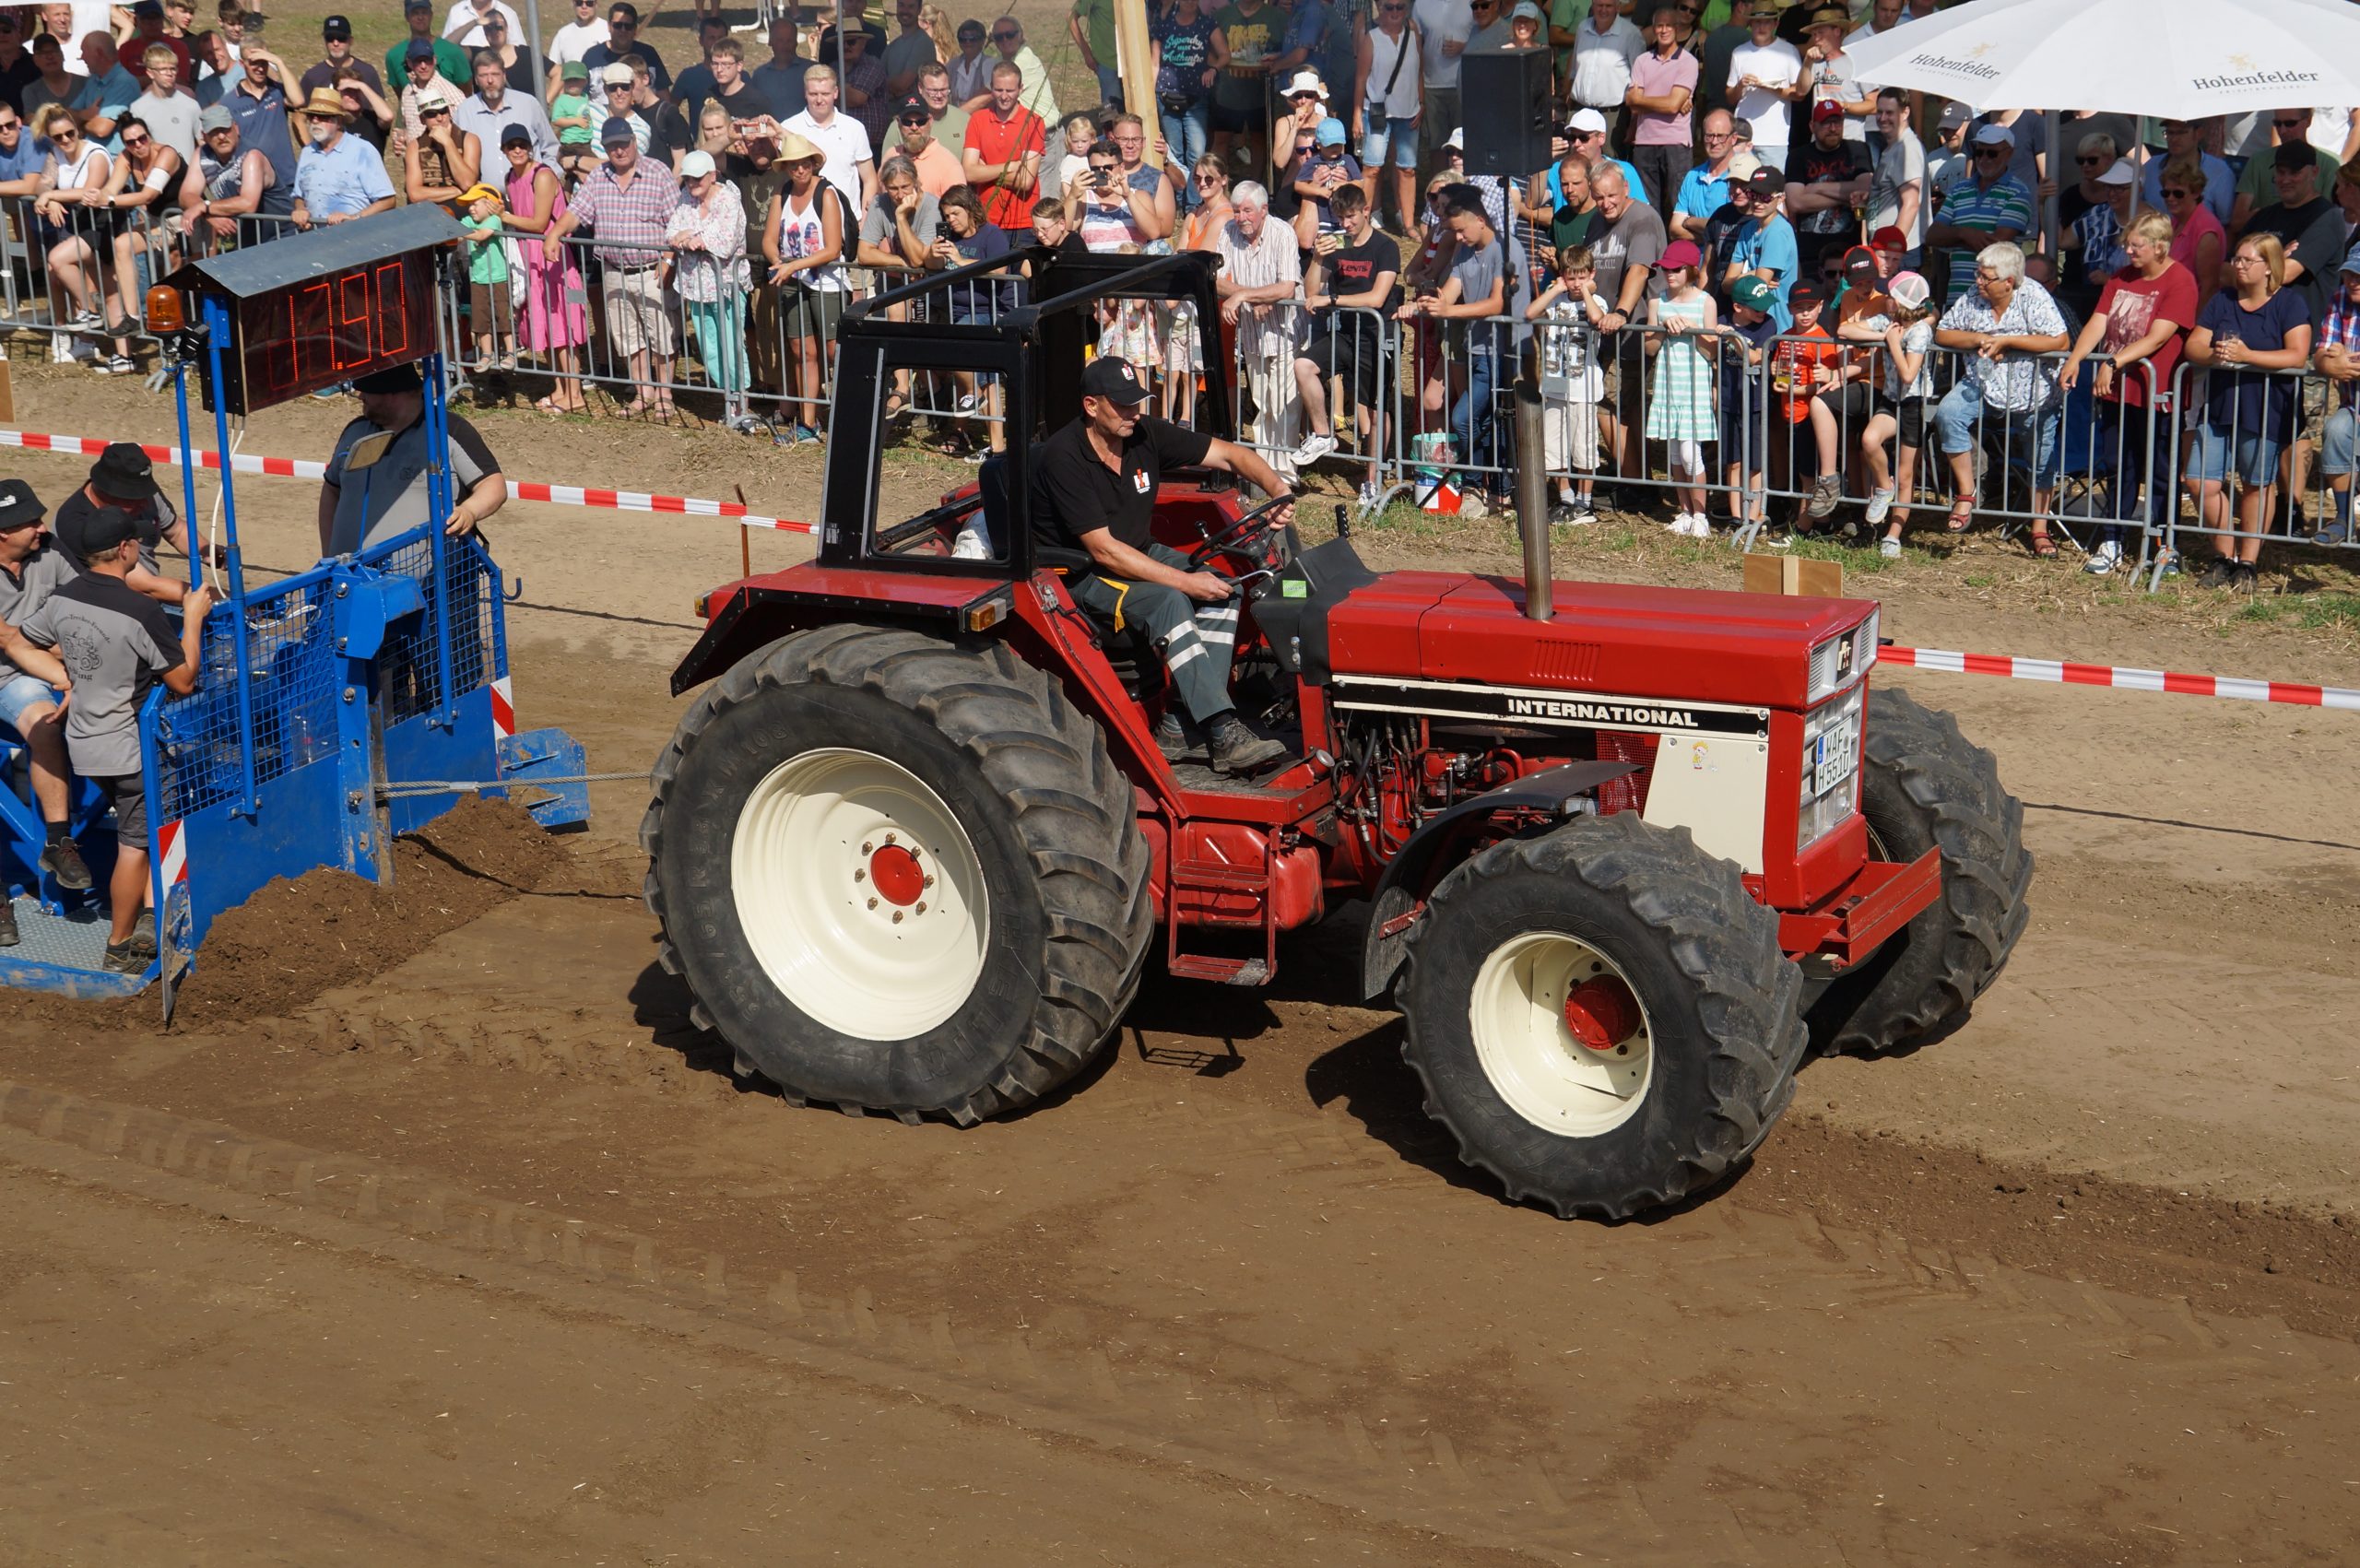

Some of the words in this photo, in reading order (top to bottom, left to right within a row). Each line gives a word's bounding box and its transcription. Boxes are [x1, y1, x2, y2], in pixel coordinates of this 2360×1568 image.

[1910, 53, 2000, 79] Hohenfelder
[2192, 70, 2319, 89] Hohenfelder
[1507, 699, 1699, 727] INTERNATIONAL
[1826, 726, 1845, 760] WAF
